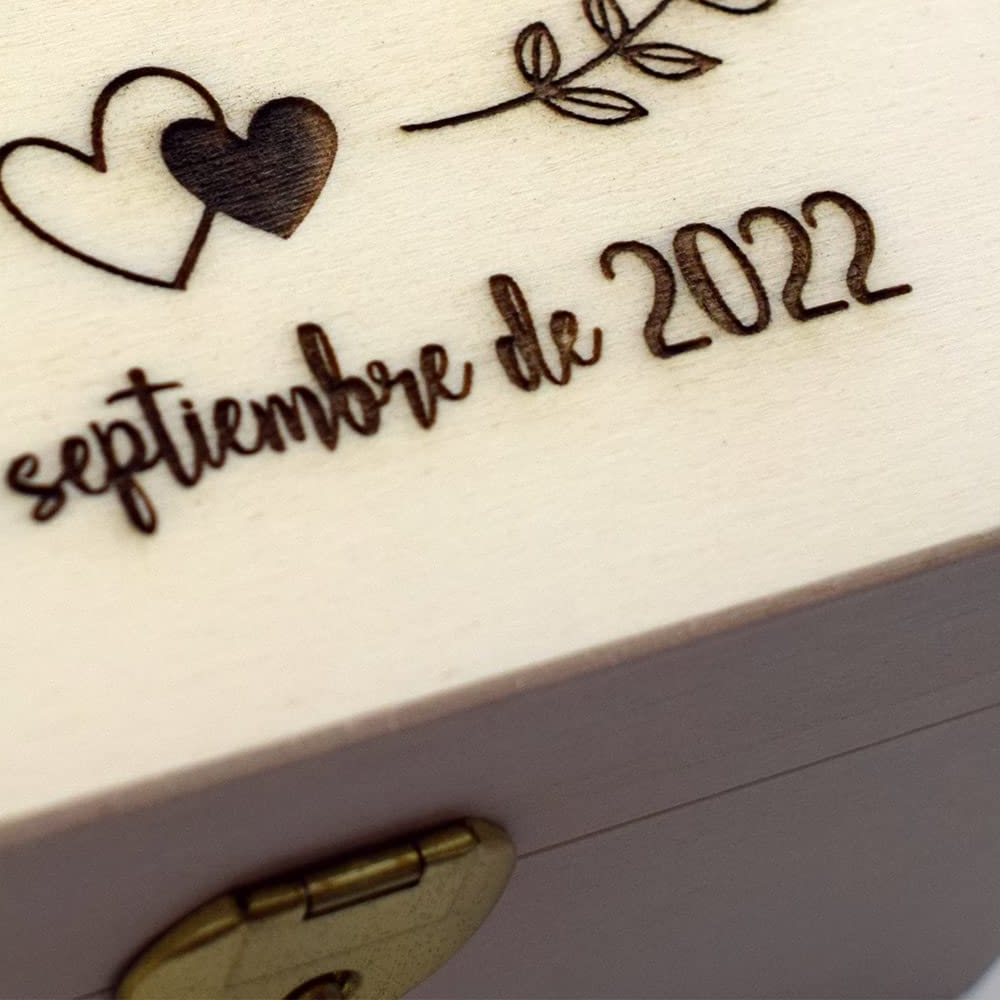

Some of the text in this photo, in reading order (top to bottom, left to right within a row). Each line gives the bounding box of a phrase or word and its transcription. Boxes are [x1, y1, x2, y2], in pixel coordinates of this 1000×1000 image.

[3, 321, 474, 537] septiembre
[488, 272, 603, 393] de
[598, 189, 913, 360] 2022
